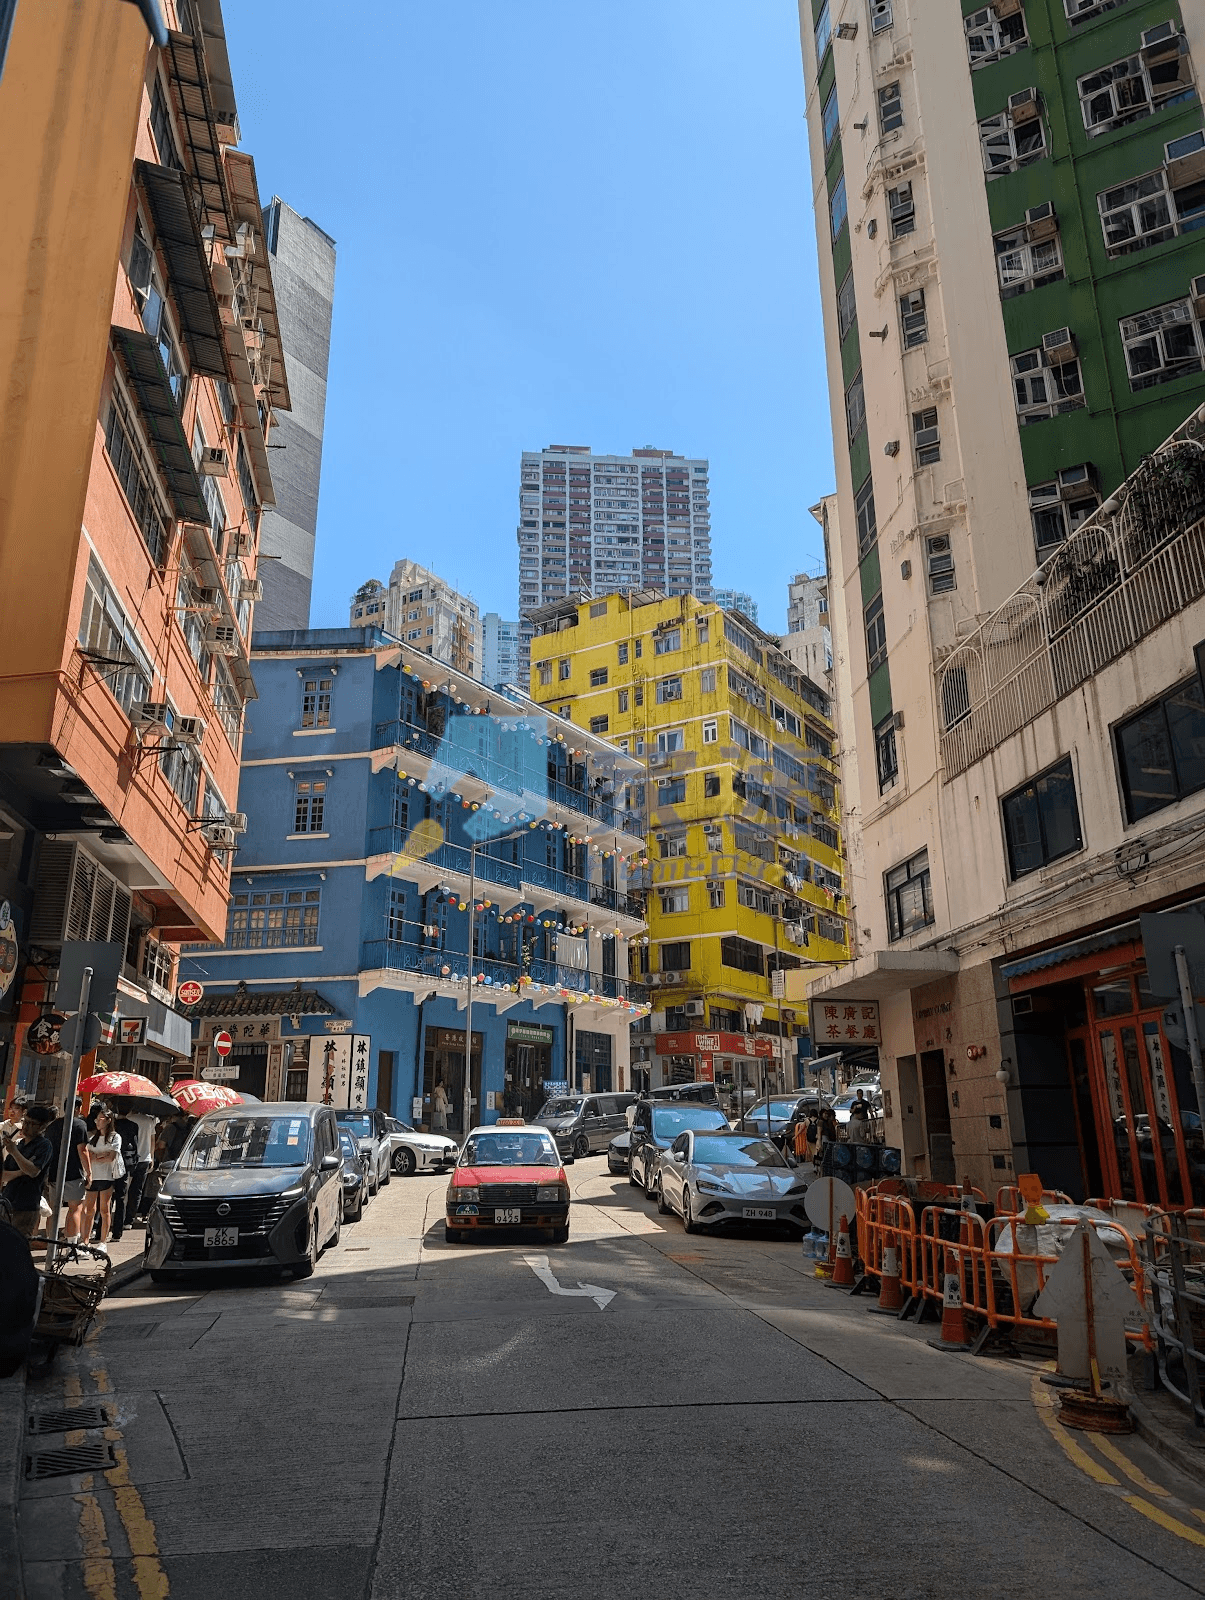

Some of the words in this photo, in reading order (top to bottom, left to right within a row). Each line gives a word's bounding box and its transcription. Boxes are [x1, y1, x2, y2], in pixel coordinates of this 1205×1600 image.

[824, 1005, 876, 1020] 陳廣記
[826, 1024, 877, 1039] 茶餐廳
[758, 1210, 773, 1218] 948
[496, 1215, 519, 1223] 9425
[215, 1228, 228, 1237] ZK
[206, 1237, 235, 1246] 5865
